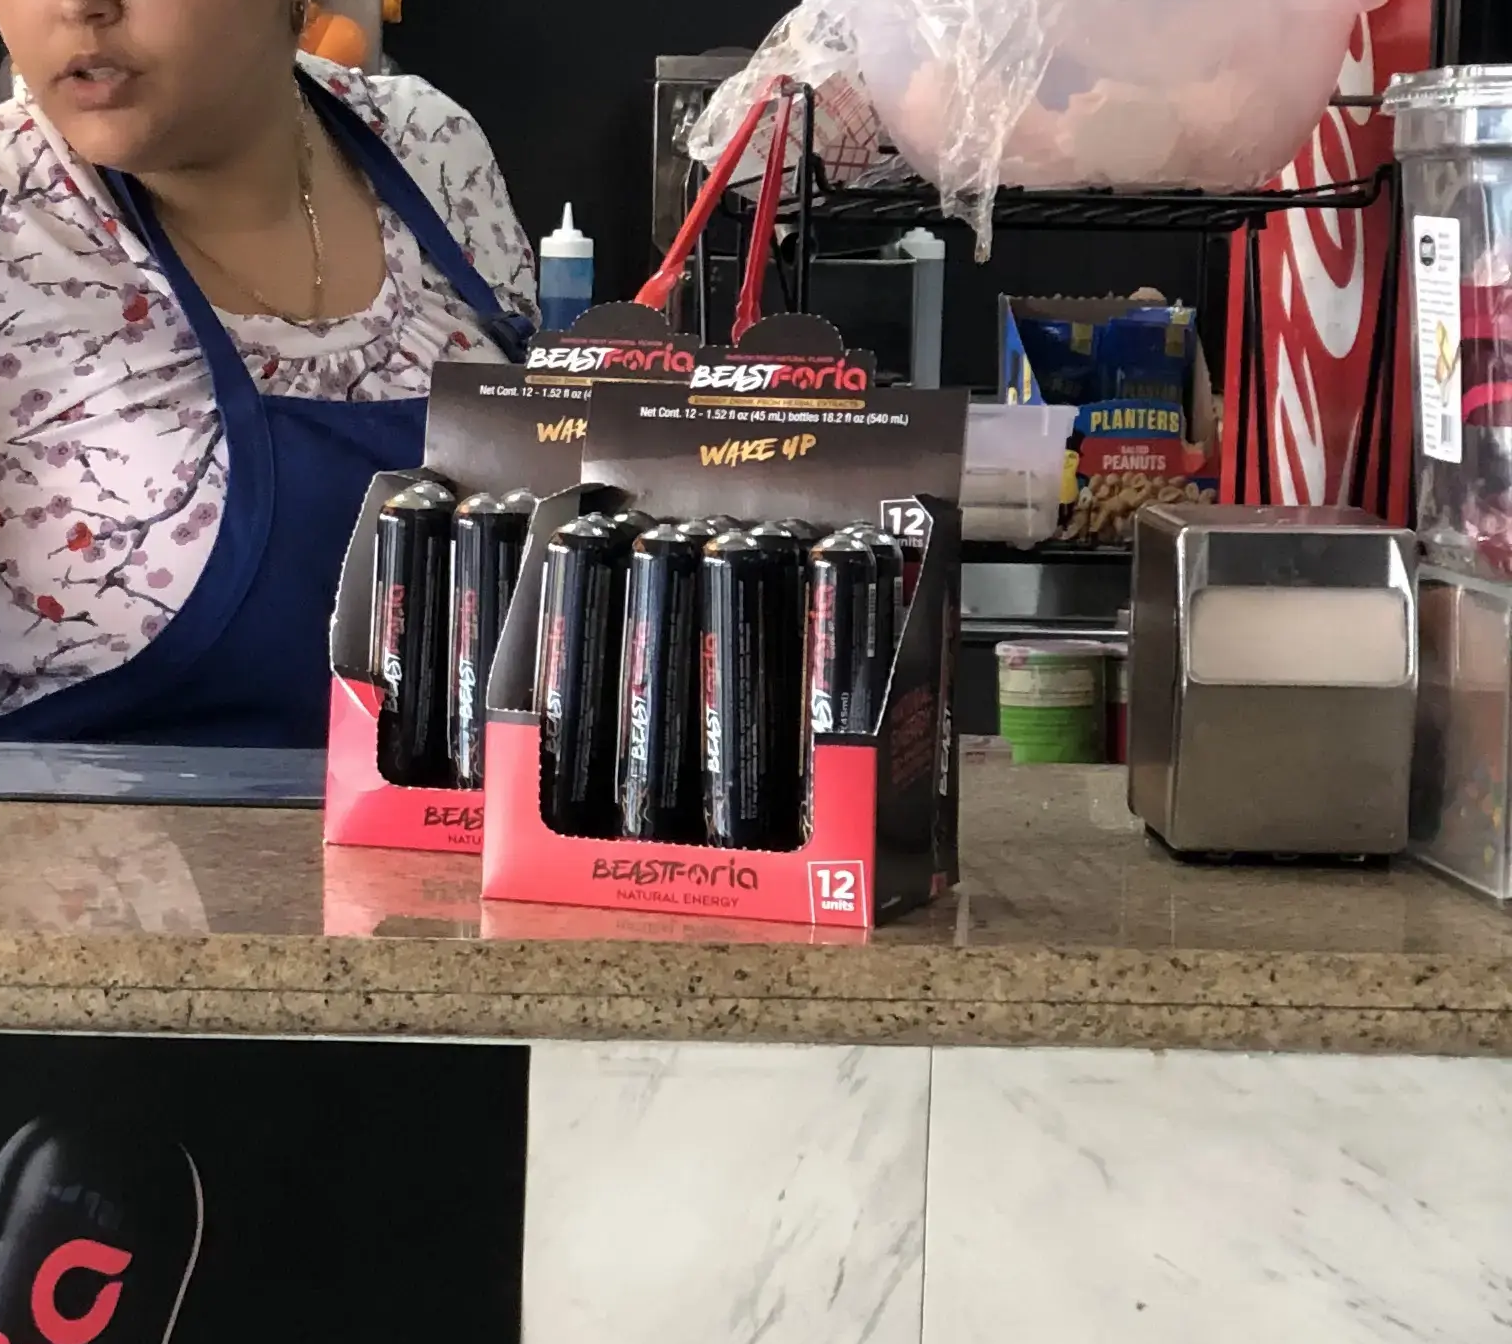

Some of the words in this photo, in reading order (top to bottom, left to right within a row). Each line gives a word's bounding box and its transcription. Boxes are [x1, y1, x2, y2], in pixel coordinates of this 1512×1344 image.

[479, 384, 495, 396] Net
[496, 385, 519, 397] Cont.
[522, 387, 534, 397] 12
[542, 387, 562, 398] 1.52
[571, 391, 582, 399] oz
[640, 406, 656, 418] Net
[658, 407, 682, 418] Cont.
[685, 408, 697, 419] 12
[706, 409, 727, 420] 1.52
[737, 412, 748, 421] oz
[750, 410, 766, 423] (45
[768, 411, 786, 423] mL)
[788, 411, 819, 423] bottles
[822, 412, 843, 424] 18.2
[853, 415, 864, 424] oz
[866, 413, 889, 426] (540
[890, 414, 909, 426] mL)
[1090, 408, 1181, 434] PLANTERS
[536, 415, 588, 444] WAK
[700, 436, 778, 468] WAKE
[781, 433, 816, 461] UP
[1102, 454, 1167, 471] PEANUTS
[887, 506, 925, 536] 12
[816, 869, 855, 900] 12
[616, 888, 677, 905] NATURAL
[684, 893, 740, 908] ENERGY
[821, 899, 855, 912] units
